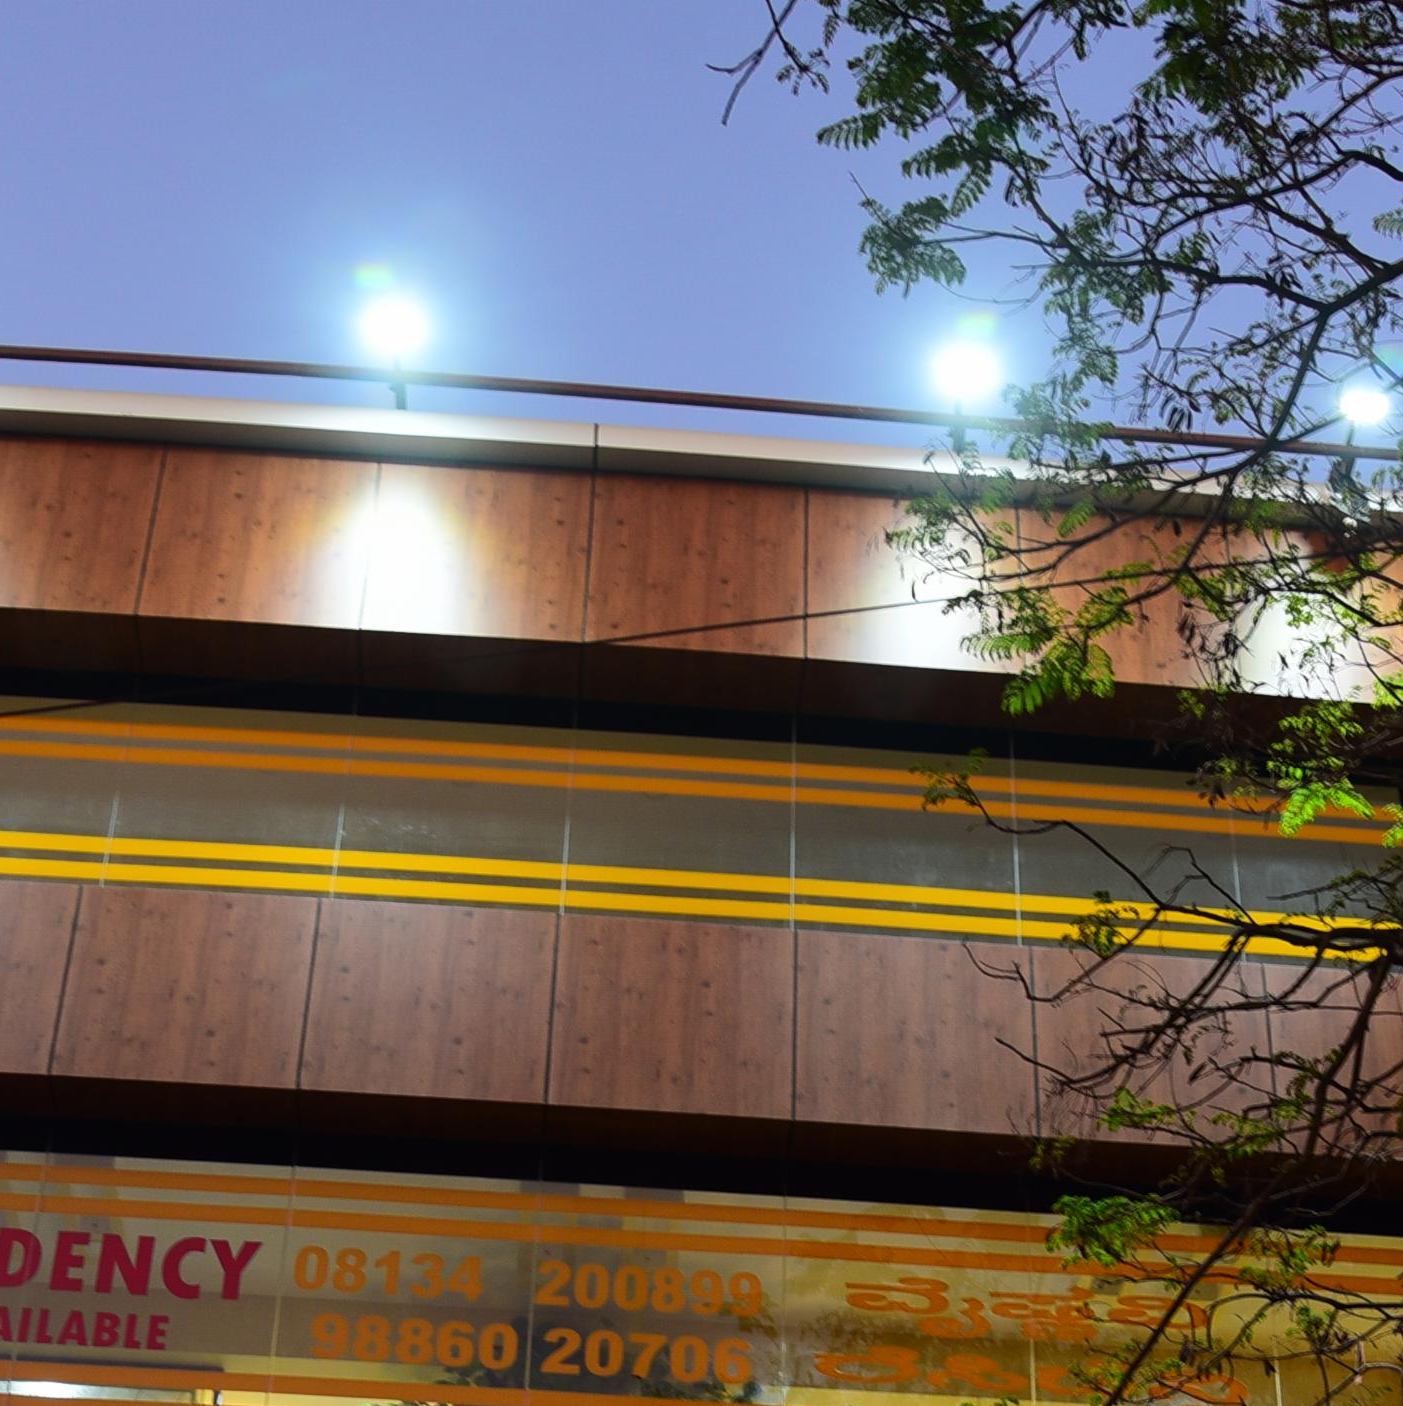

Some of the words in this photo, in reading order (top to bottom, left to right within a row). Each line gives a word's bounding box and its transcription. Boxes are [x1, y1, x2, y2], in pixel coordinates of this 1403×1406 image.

[296, 1245, 483, 1300] 08134
[535, 1260, 764, 1318] 200899
[312, 1313, 518, 1371] 98860
[541, 1328, 752, 1384] 20706
